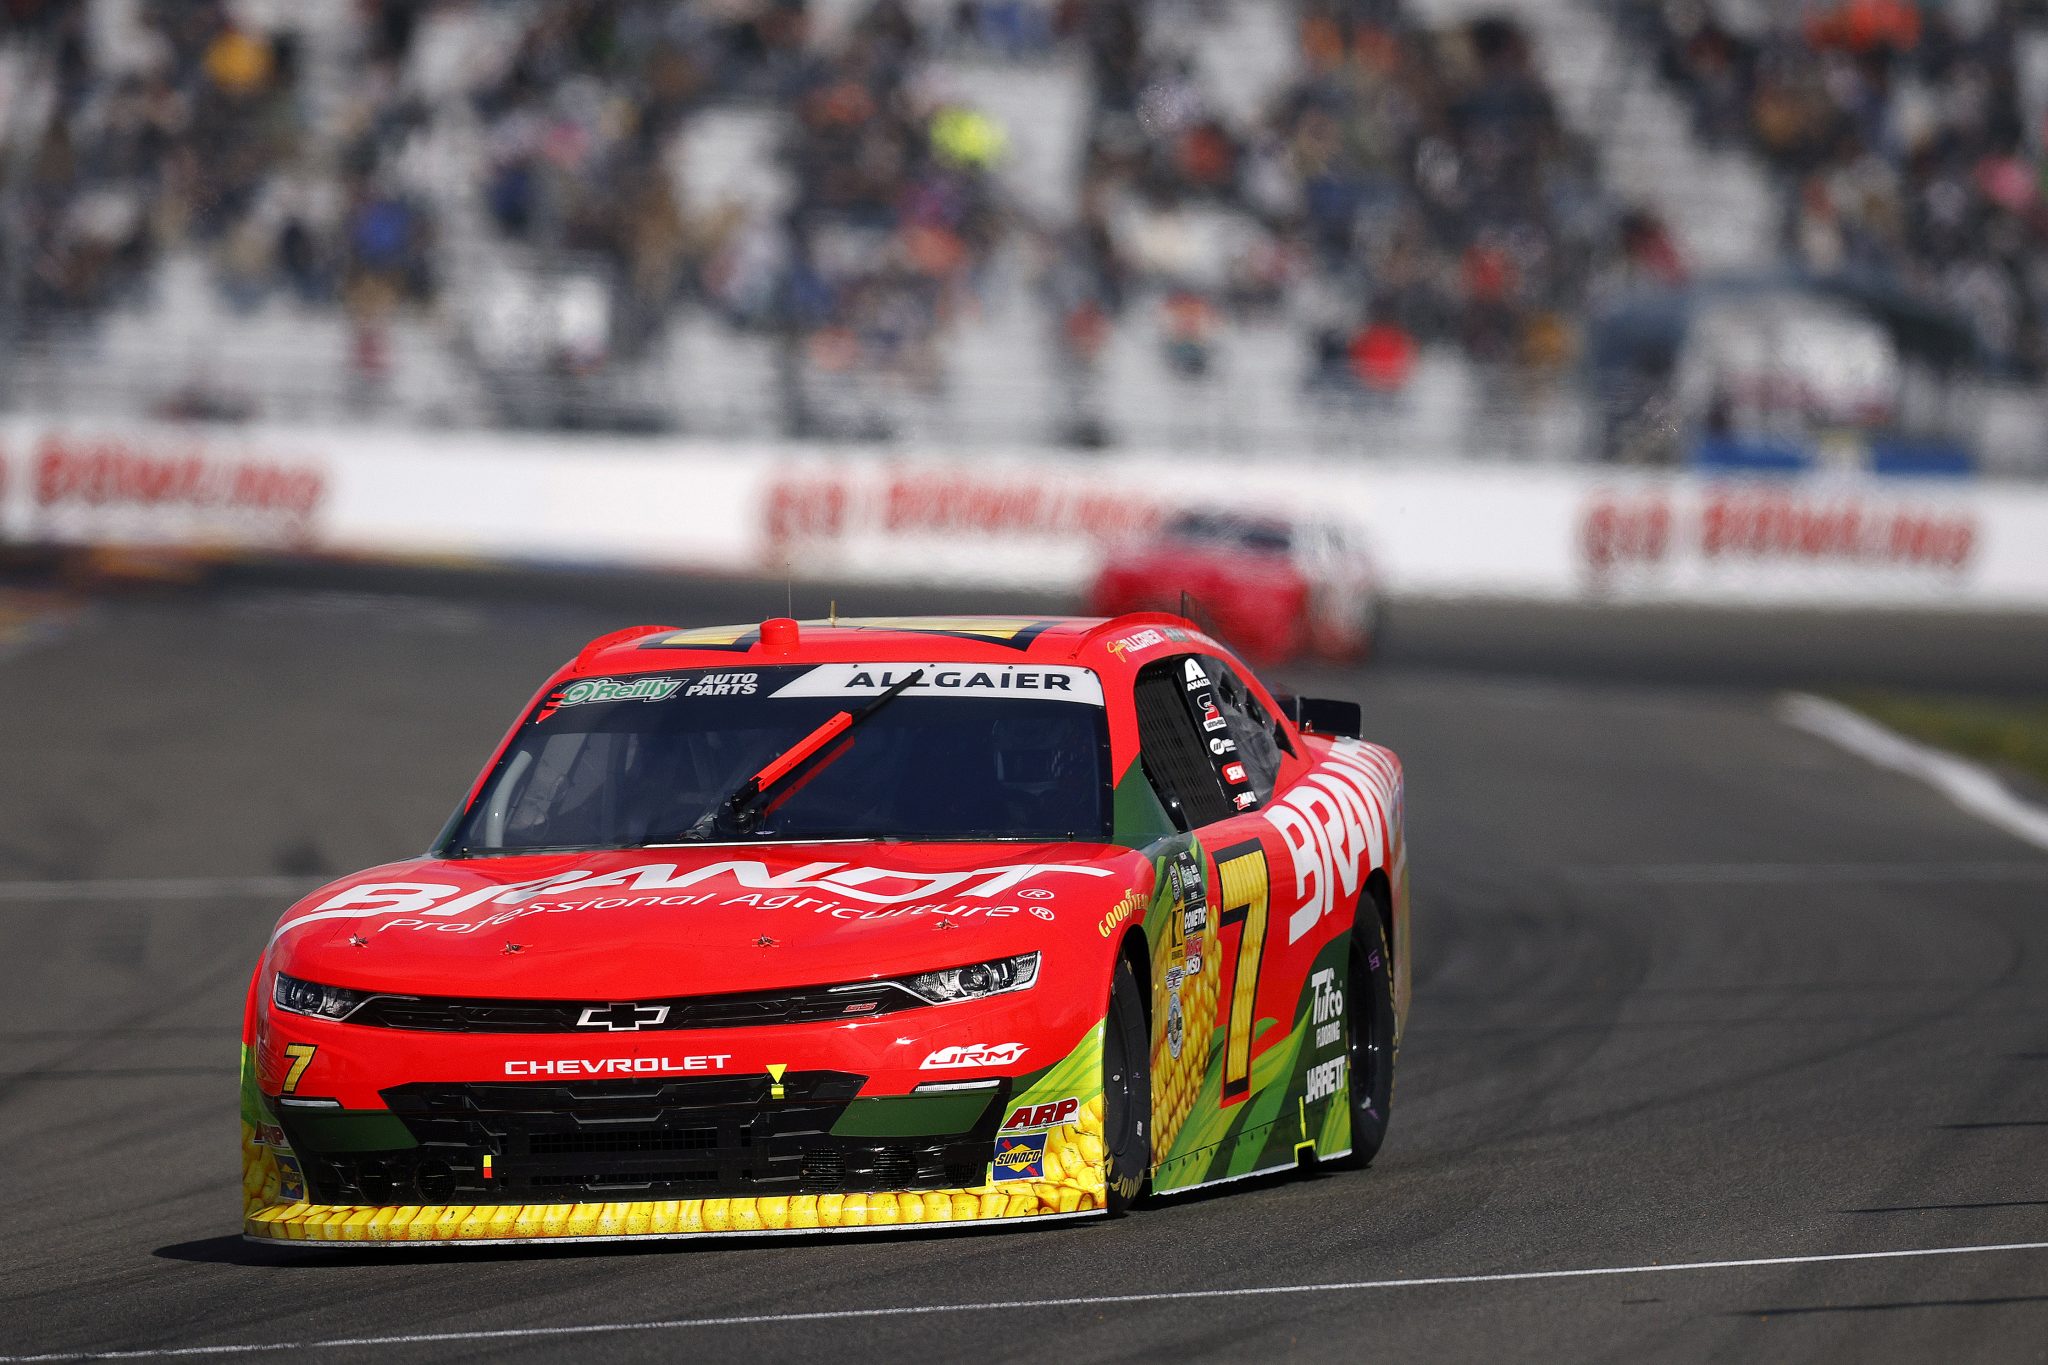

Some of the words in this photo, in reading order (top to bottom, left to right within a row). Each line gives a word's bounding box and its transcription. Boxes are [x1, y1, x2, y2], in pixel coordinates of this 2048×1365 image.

[558, 678, 688, 707] O'Reilly
[685, 683, 758, 696] PARTS
[697, 673, 758, 686] AUTO
[270, 861, 1114, 940] BRANDT
[377, 892, 704, 934] Professional
[719, 892, 1020, 920] Agriculture
[1212, 837, 1271, 1101] 7
[281, 1042, 318, 1095] 7
[504, 1054, 731, 1075] CHEVROLET
[928, 1050, 1017, 1067] JRM
[1305, 1055, 1346, 1104] JARRETT
[1002, 1098, 1078, 1129] ARP
[996, 1150, 1042, 1166] SUNOCO
